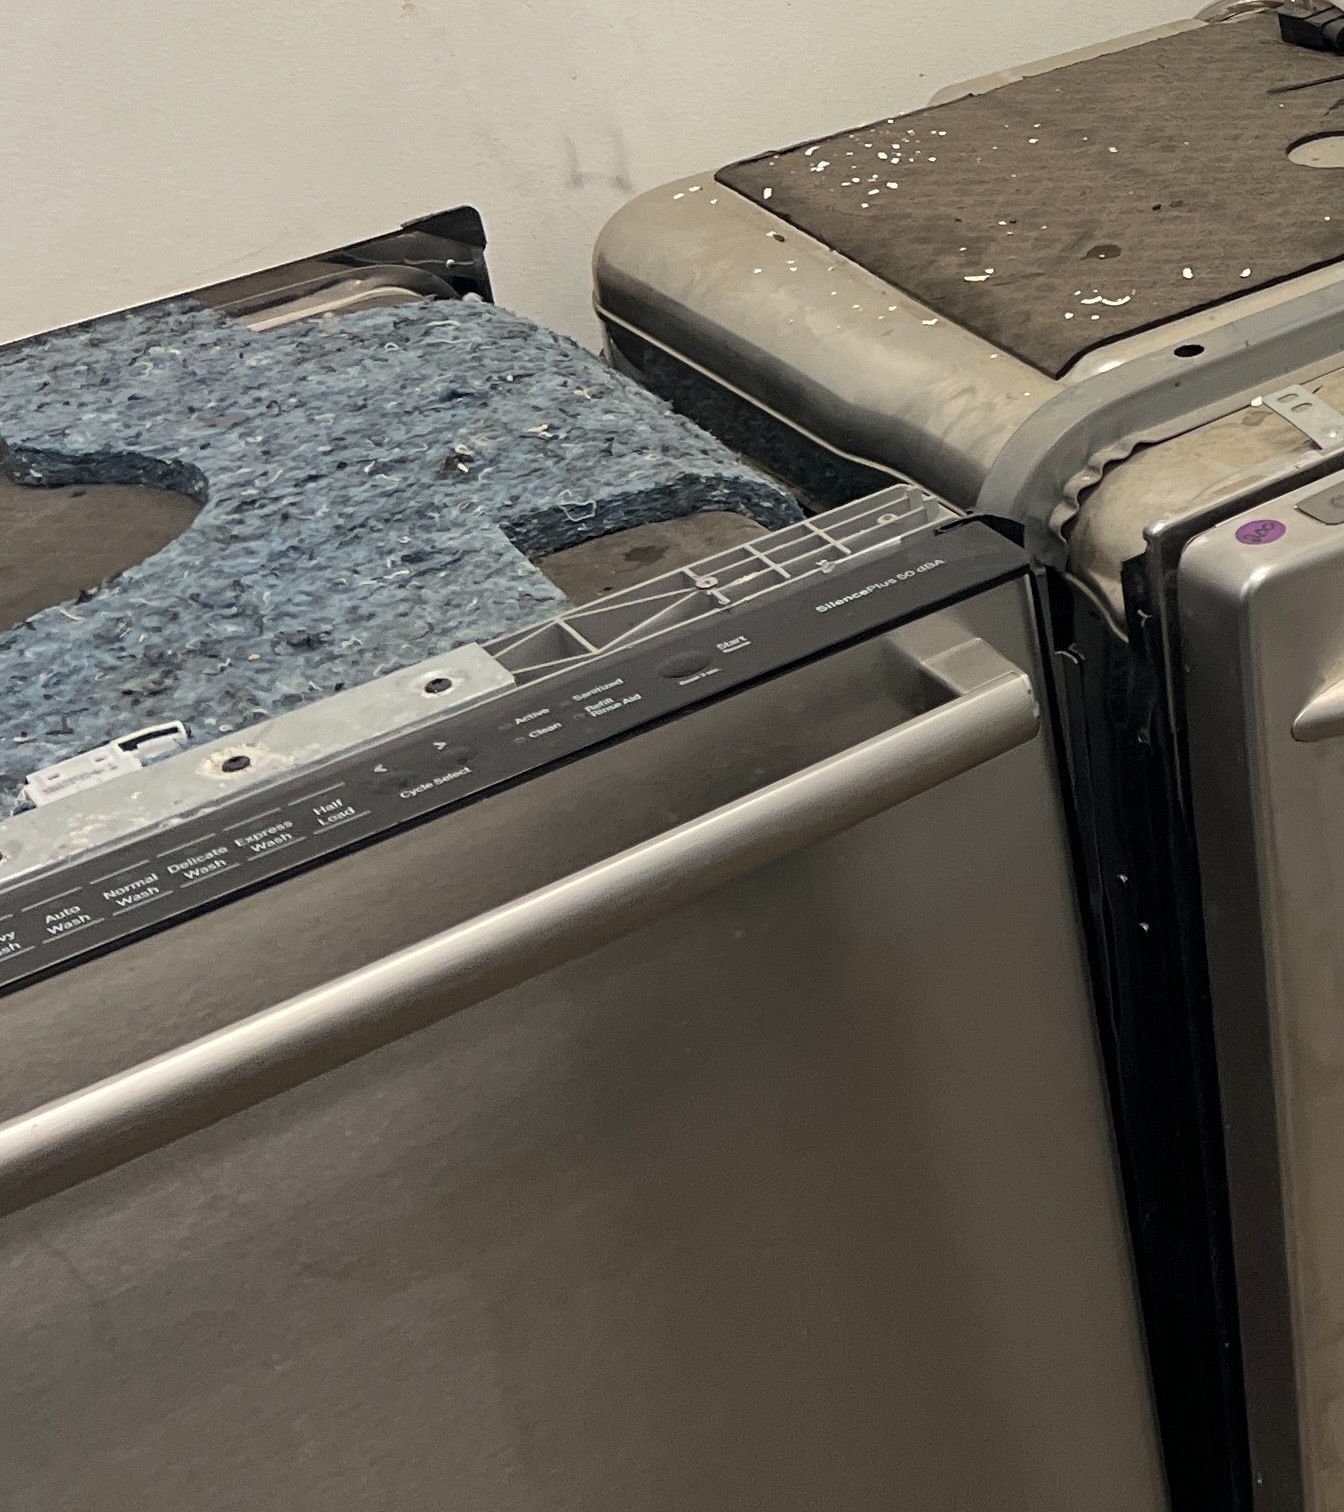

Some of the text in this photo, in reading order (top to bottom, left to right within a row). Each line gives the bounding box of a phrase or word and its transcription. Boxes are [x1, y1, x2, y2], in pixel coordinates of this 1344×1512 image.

[815, 577, 898, 614] SilencePlus
[916, 559, 946, 573] dBA
[716, 635, 749, 651] Start
[572, 678, 624, 701] Sanitized
[590, 693, 642, 717] Rinse Aid
[514, 708, 551, 726] Active
[528, 722, 562, 740] Clean
[398, 767, 472, 799] Cycle Select
[312, 798, 343, 817] Half
[317, 806, 356, 827] Load
[234, 819, 294, 850] Express
[250, 831, 293, 854] Wash
[166, 844, 229, 875] Delicate
[183, 857, 228, 881] Wash
[102, 872, 159, 901] Normal
[115, 885, 161, 908] Wash
[44, 904, 81, 924] Auto
[46, 913, 92, 936] Wash
